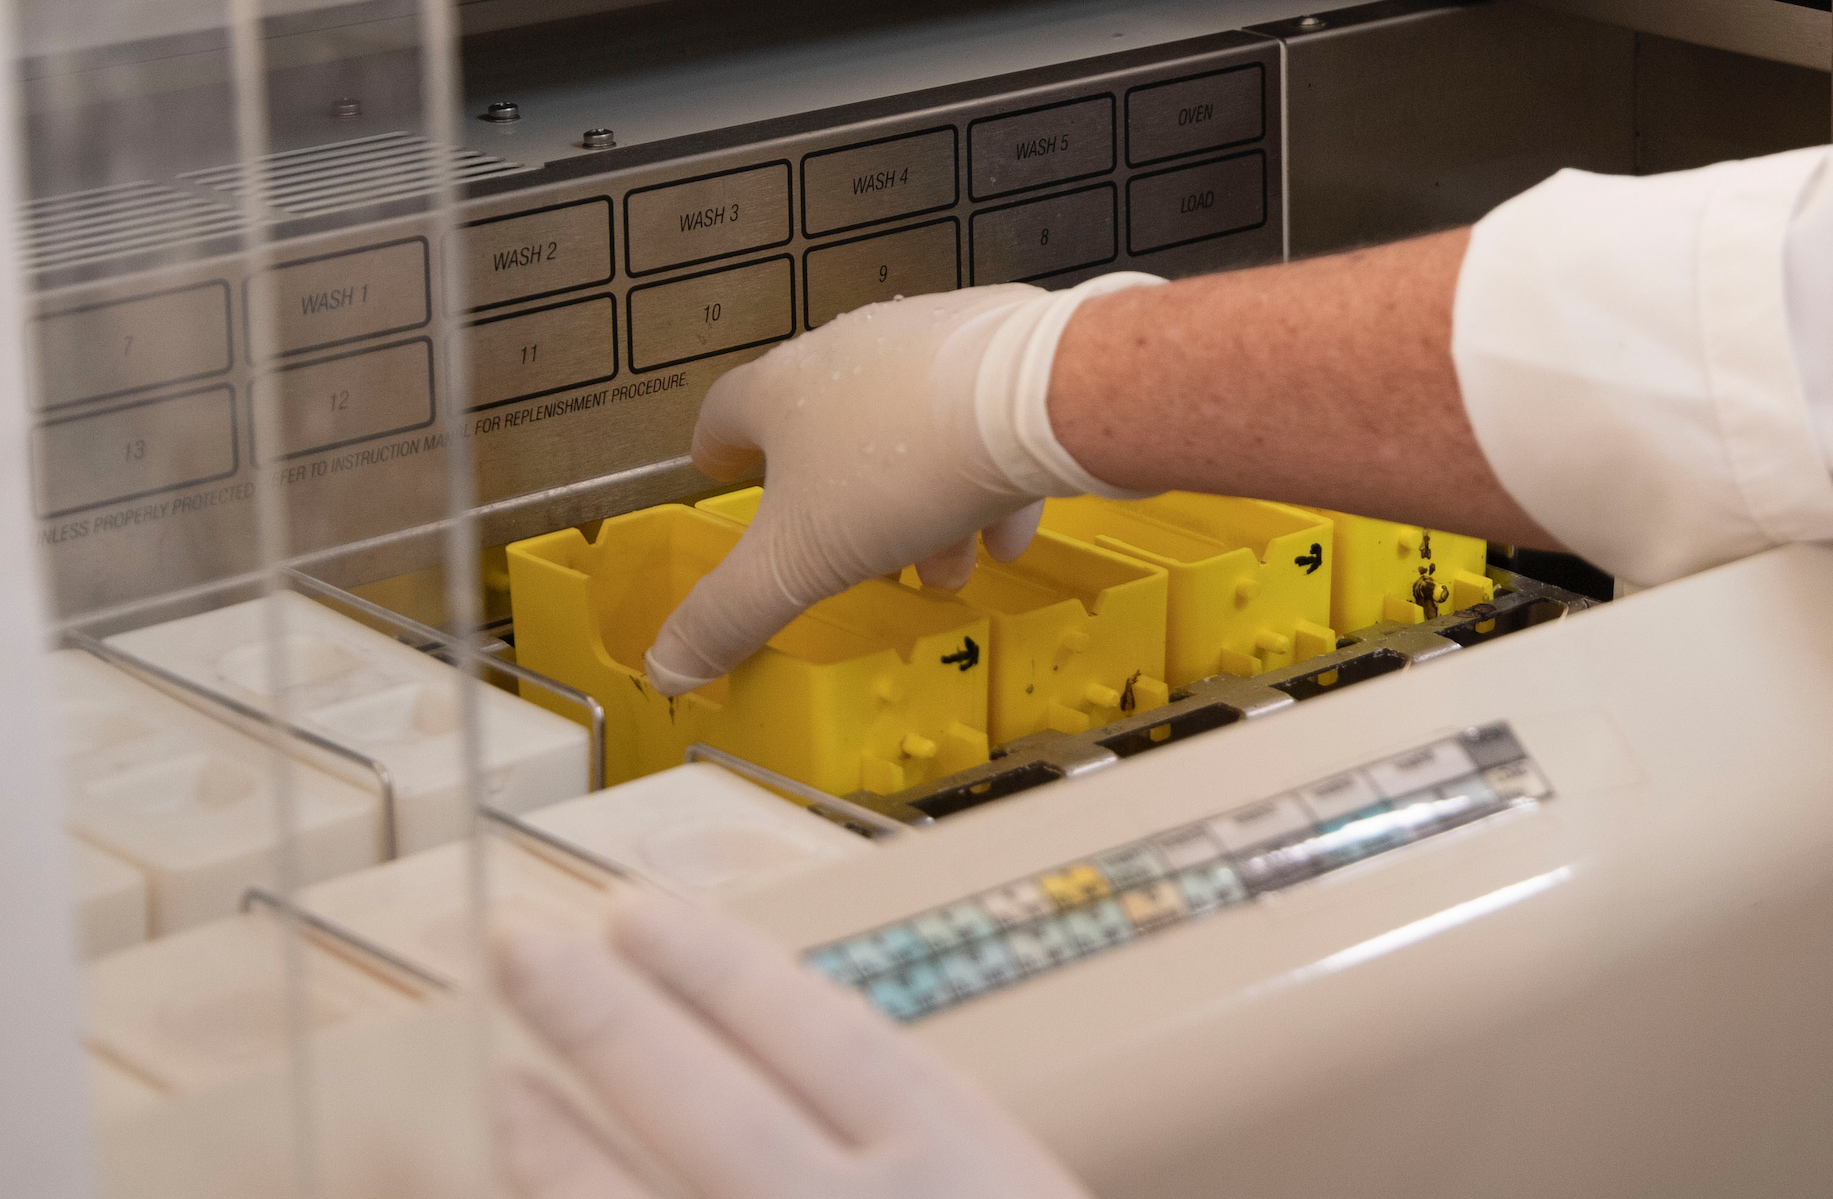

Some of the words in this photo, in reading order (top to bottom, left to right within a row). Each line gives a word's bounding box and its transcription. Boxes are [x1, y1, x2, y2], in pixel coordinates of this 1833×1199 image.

[1177, 104, 1213, 126] OVEN
[1015, 135, 1056, 161] WASH
[1060, 133, 1069, 151] 5
[852, 173, 896, 196] WASH
[898, 168, 909, 186] 4
[1180, 191, 1215, 214] LOAD
[679, 209, 725, 233] WASH
[729, 204, 740, 223] 3
[1040, 229, 1049, 246] 8
[492, 246, 543, 272] WASH
[546, 241, 558, 262] 2
[878, 265, 889, 283] 9
[301, 286, 353, 314] WASH
[361, 284, 370, 303] 1
[703, 303, 721, 323] 10
[123, 336, 134, 355] 7
[520, 344, 538, 365] 11
[329, 389, 350, 413] 12
[39, 520, 89, 545] NLESS
[93, 503, 169, 533] PROPERLY
[268, 466, 306, 486] FER
[310, 458, 327, 477] TO
[332, 439, 419, 472] INSTRUCTION
[423, 423, 471, 451] MAL
[475, 416, 501, 436] FOR
[504, 390, 607, 429] REPLENISHMENT
[611, 372, 689, 403] PROCEDURE.
[124, 439, 146, 462] 13
